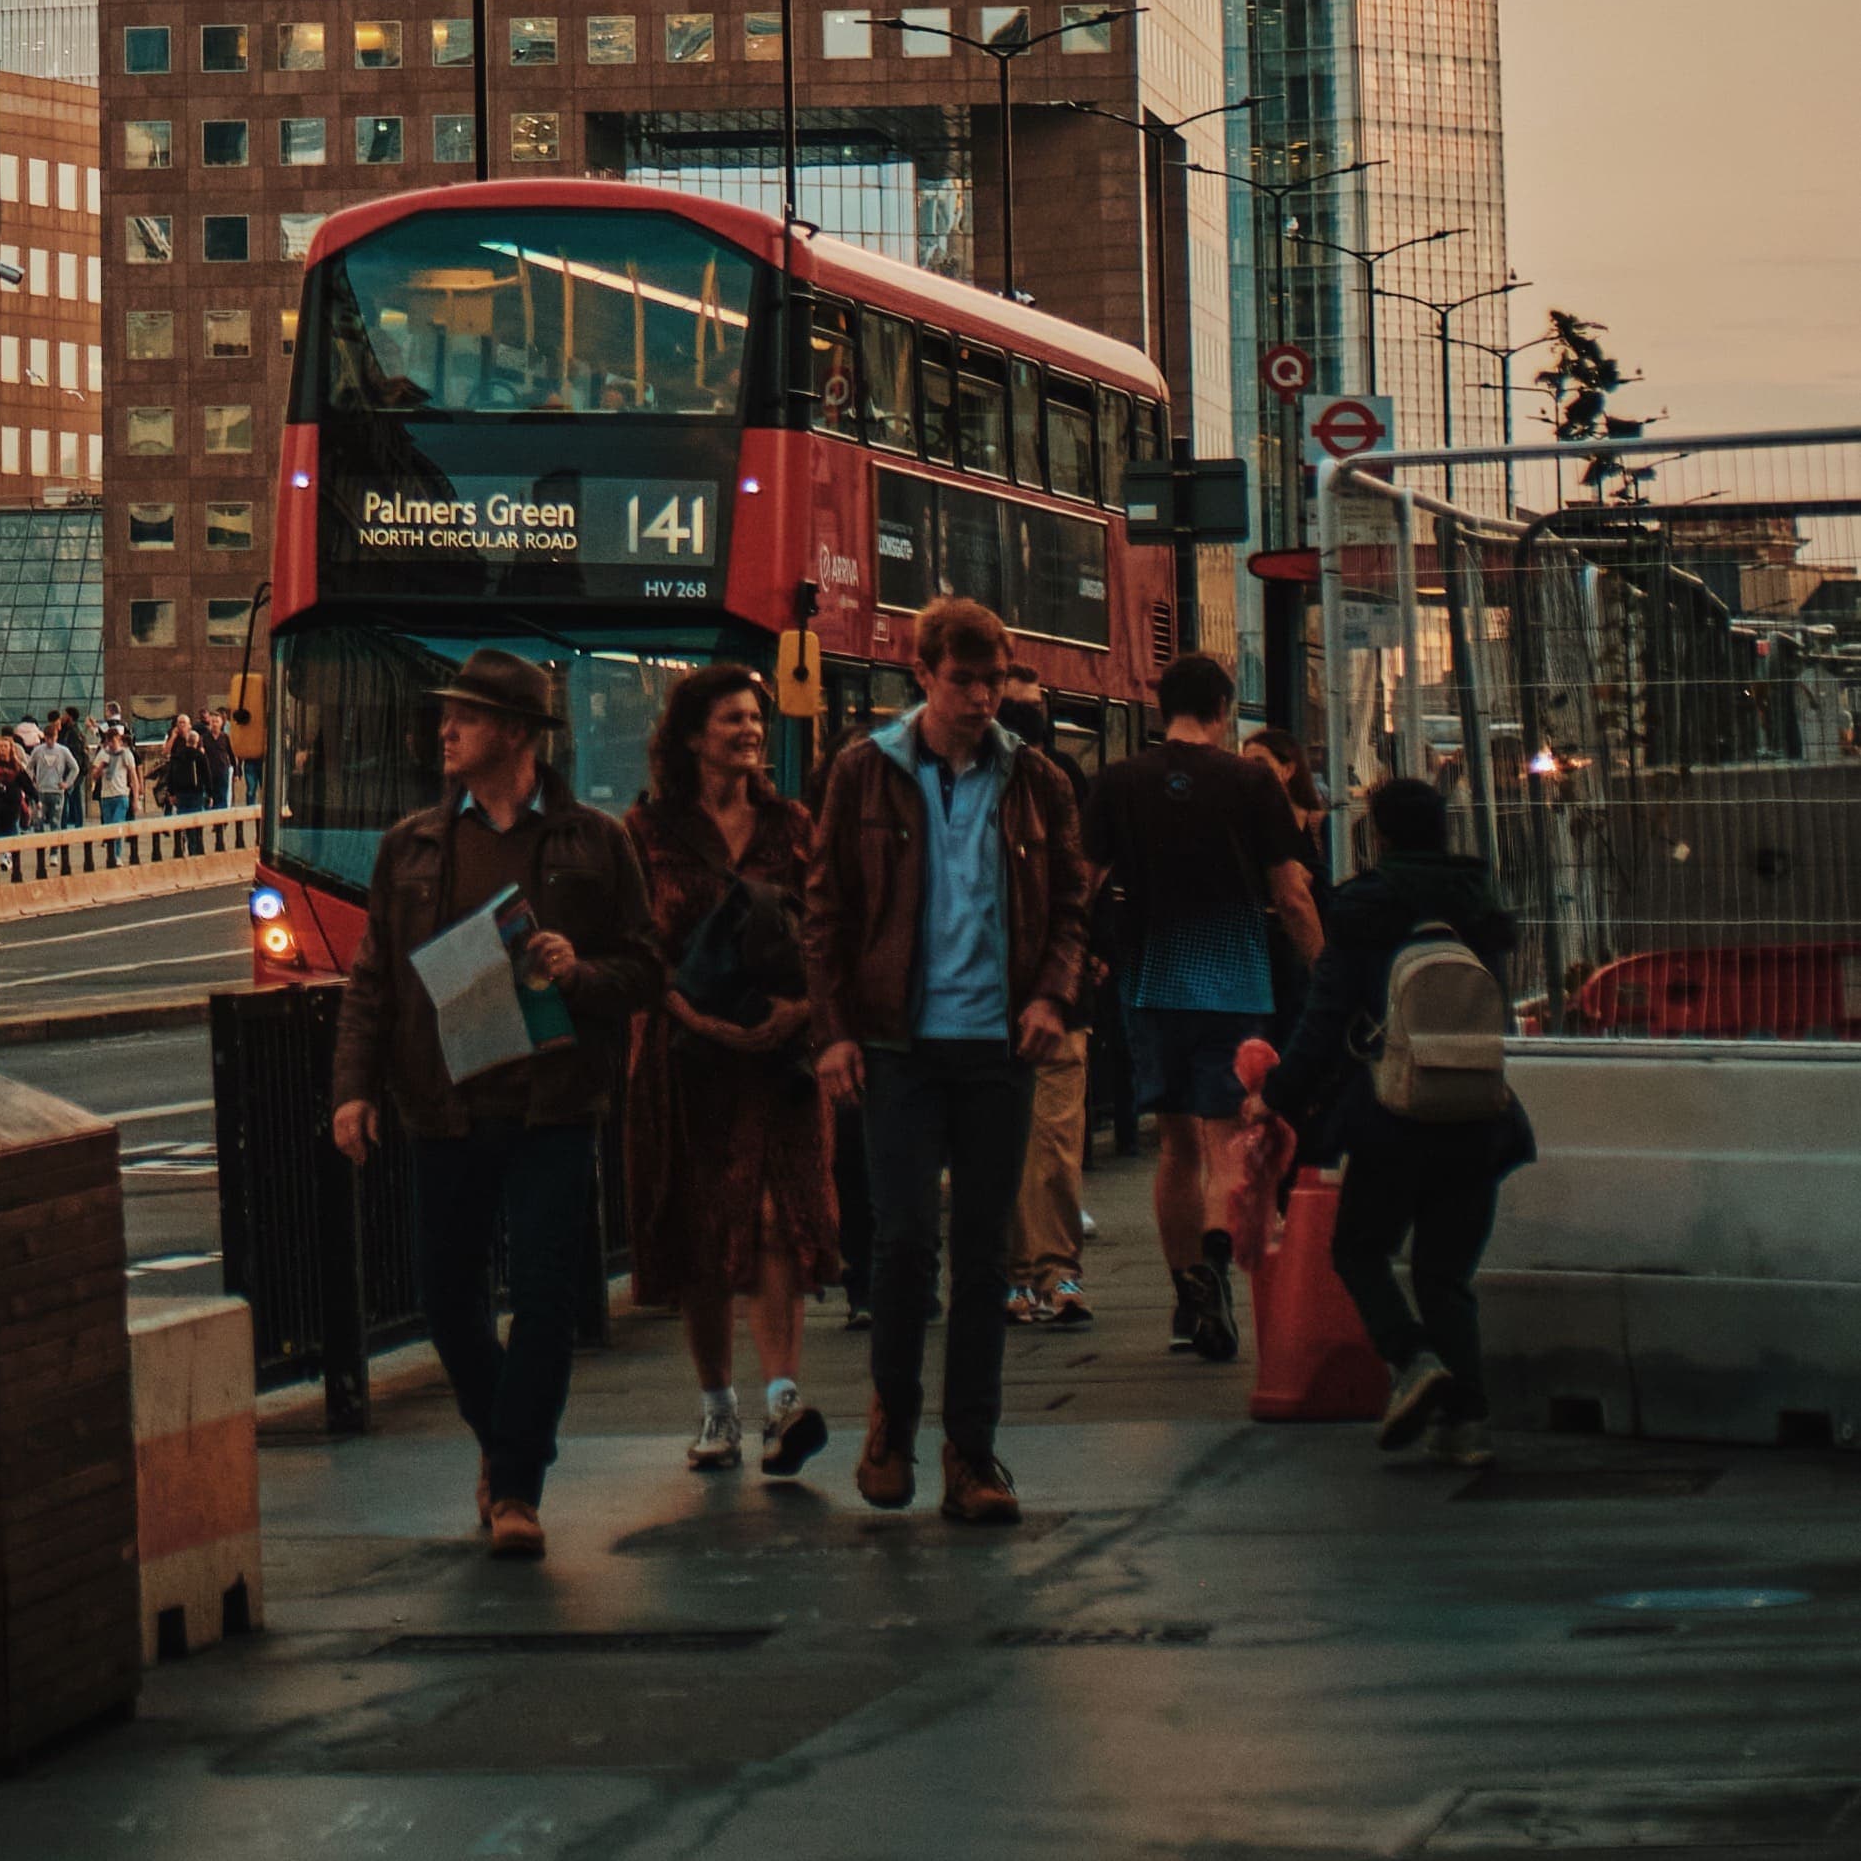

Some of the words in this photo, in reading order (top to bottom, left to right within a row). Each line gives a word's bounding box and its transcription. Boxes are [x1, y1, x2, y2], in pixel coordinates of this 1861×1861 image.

[1272, 355, 1303, 387] Q
[363, 492, 477, 525] Palmers
[487, 493, 575, 528] Green
[627, 494, 705, 555] 141
[359, 529, 424, 547] NORTH
[430, 530, 520, 549] CIRCULAR
[525, 532, 578, 550] ROAD
[645, 581, 673, 598] HV
[677, 581, 707, 599] 268
